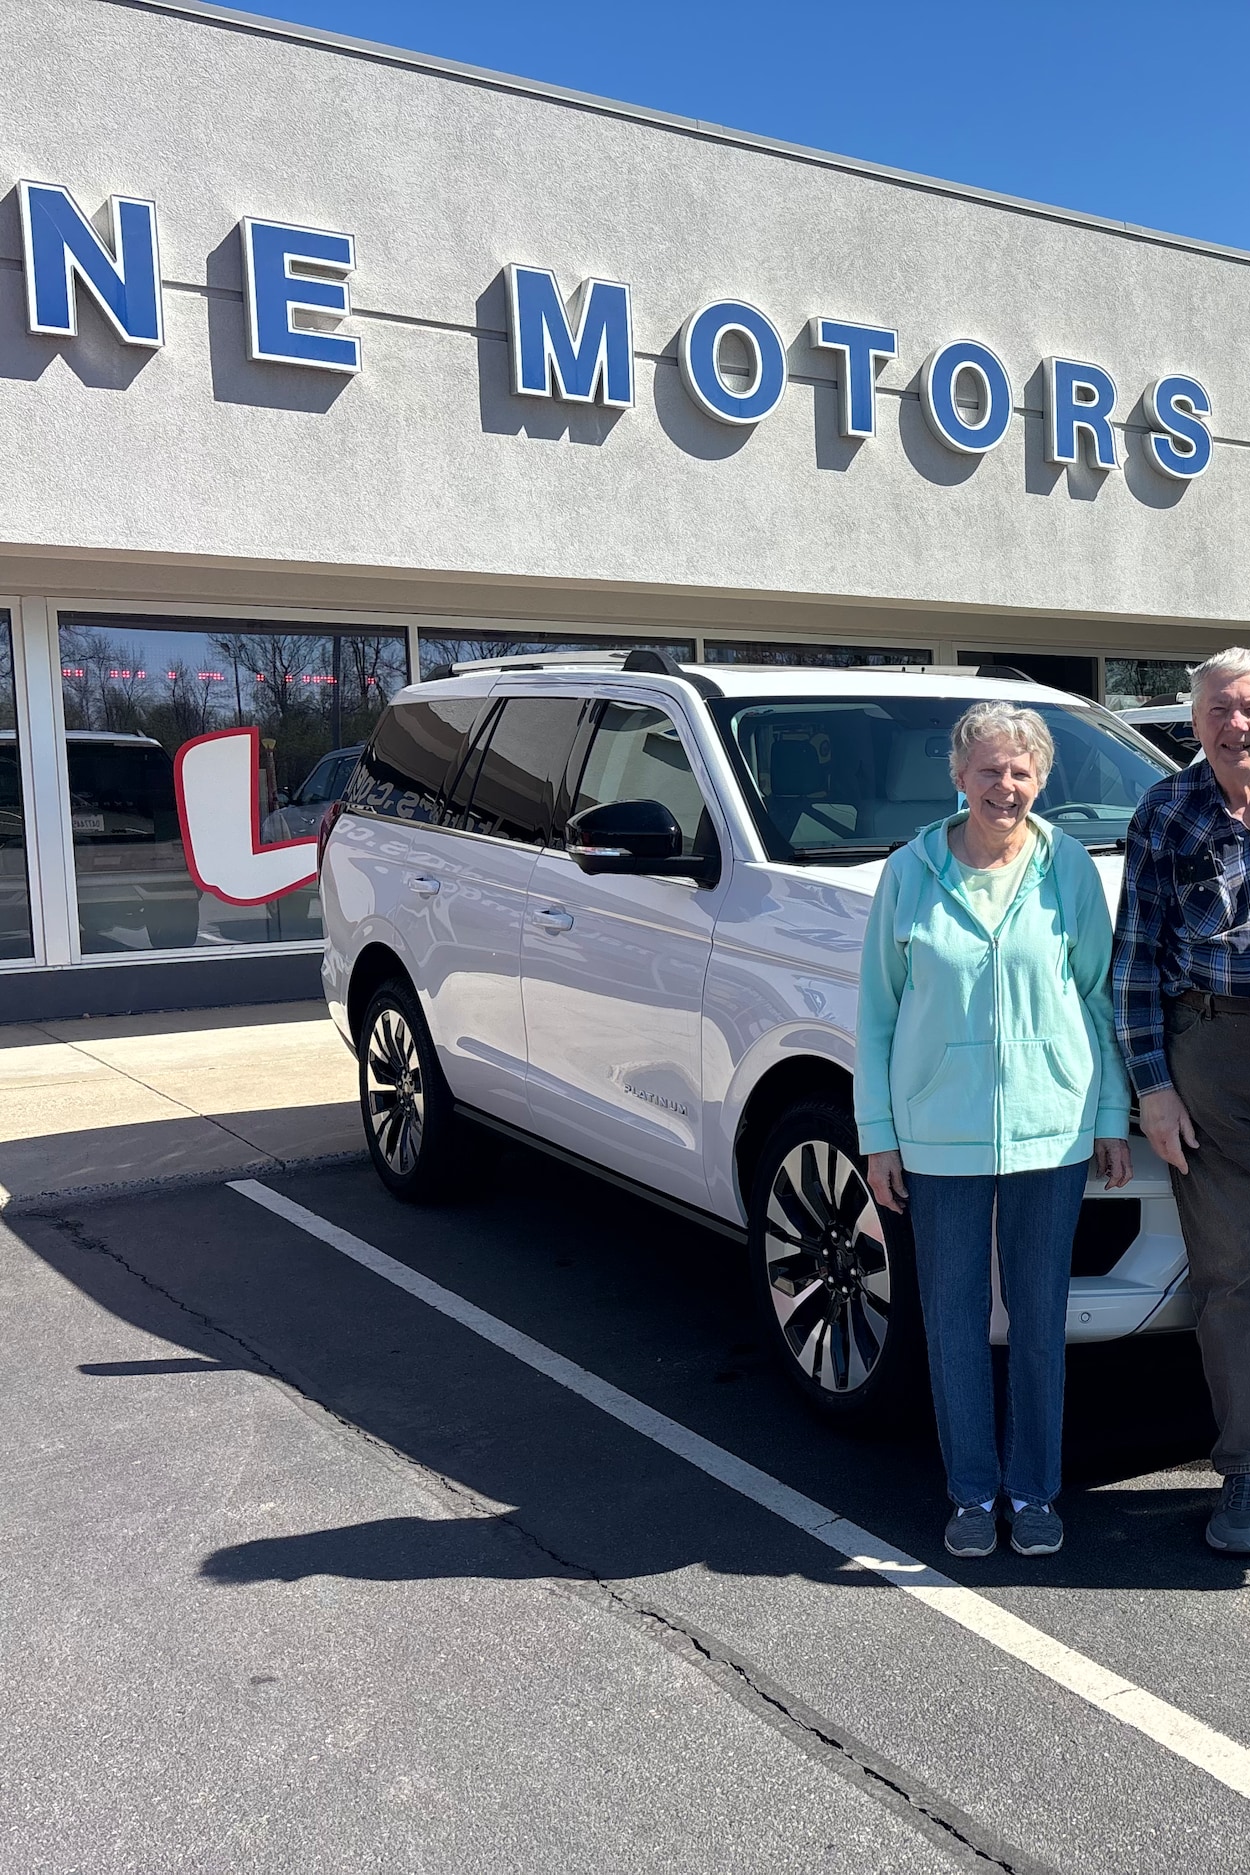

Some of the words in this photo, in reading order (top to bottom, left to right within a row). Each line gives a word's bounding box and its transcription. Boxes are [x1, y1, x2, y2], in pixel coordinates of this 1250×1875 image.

[17, 178, 363, 375] NE
[503, 262, 1215, 482] MOTORS
[623, 1083, 689, 1117] PLATINUM
